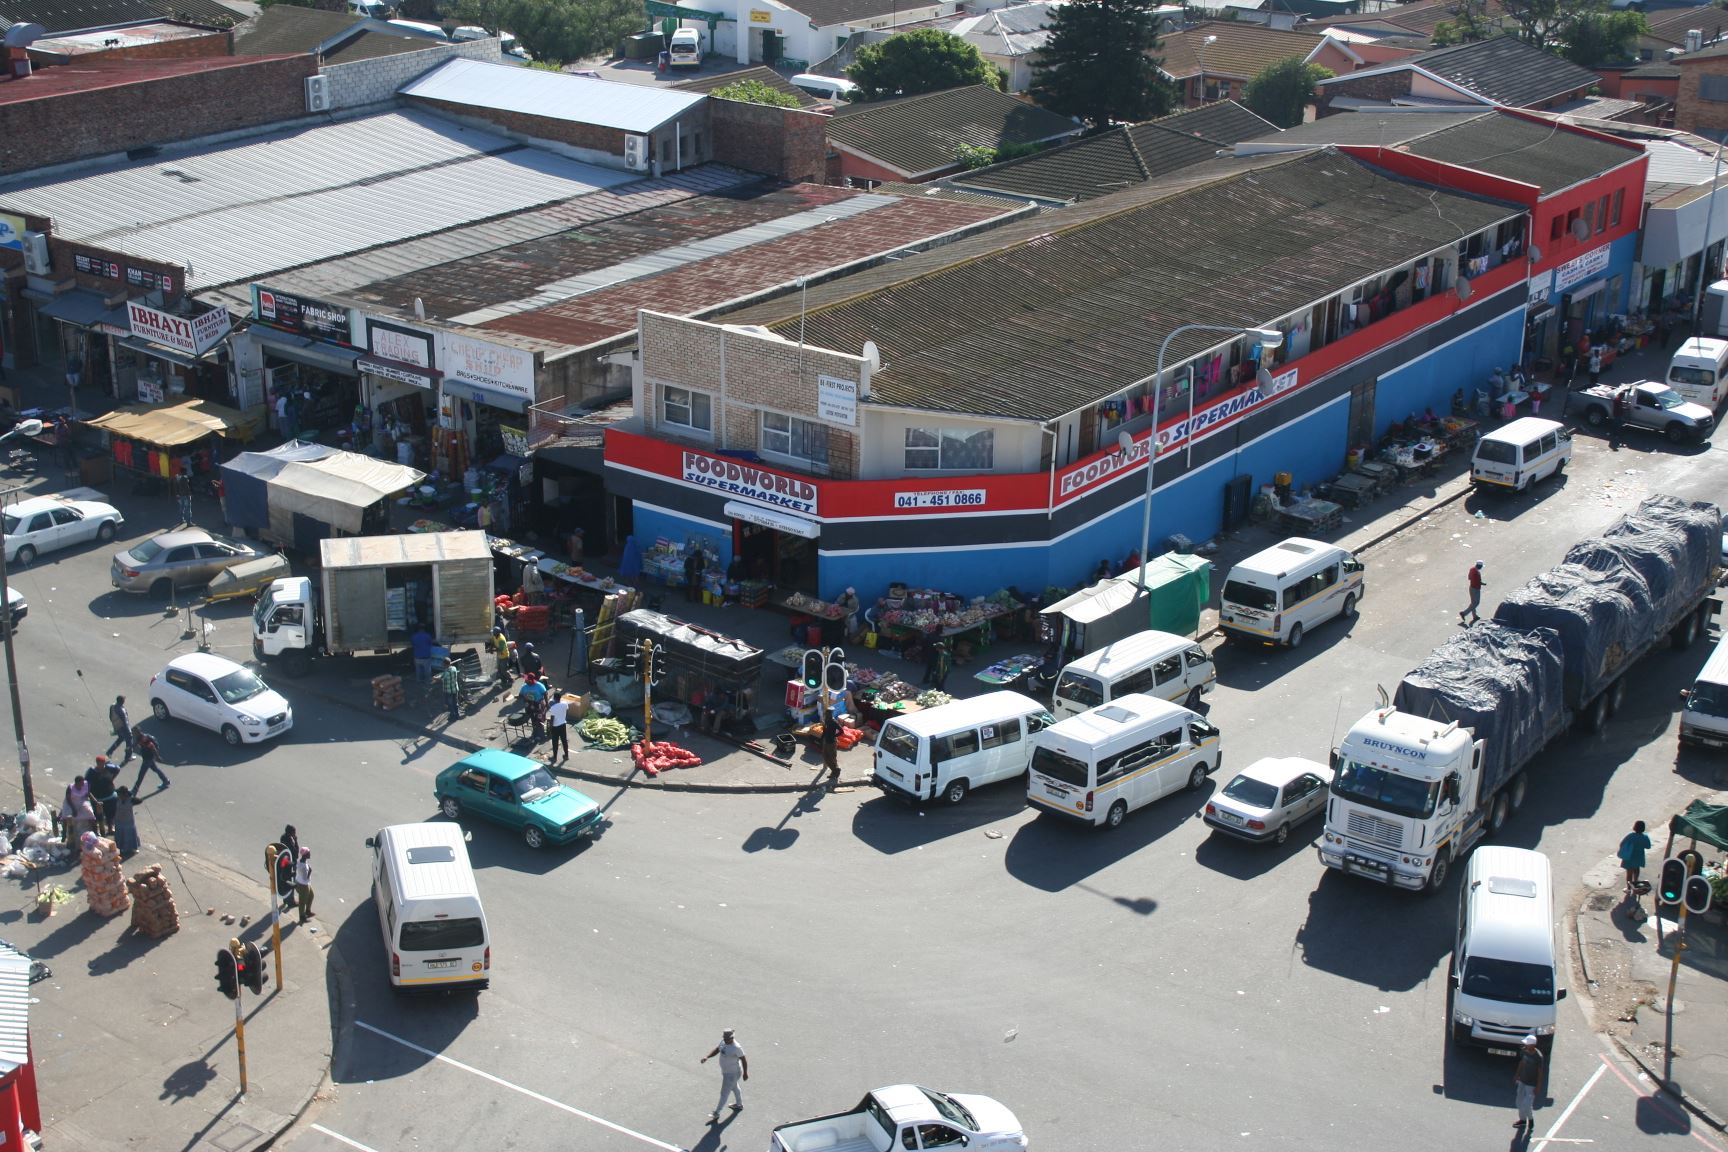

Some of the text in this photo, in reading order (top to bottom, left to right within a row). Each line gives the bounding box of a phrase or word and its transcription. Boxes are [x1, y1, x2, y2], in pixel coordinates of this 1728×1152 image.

[128, 267, 142, 276] KHAN
[131, 305, 191, 339] IBHAYI
[194, 307, 227, 329] IBHAYI
[301, 304, 327, 319] FABRIC
[327, 311, 346, 324] SHOP
[133, 324, 170, 342] FURNITURE
[177, 337, 194, 350] BEDS
[197, 317, 227, 336] FURNITURE
[205, 329, 219, 340] BEDS
[836, 382, 855, 393] PROJECTS
[1062, 371, 1297, 494] FOODWORD SUPERMARET
[685, 452, 815, 501] FOODWORLD
[684, 472, 814, 513] SUPERMARKET
[897, 496, 918, 507] 041
[929, 495, 950, 506] 451
[954, 493, 982, 505] 0866
[1363, 737, 1427, 760] BRUYNCON
